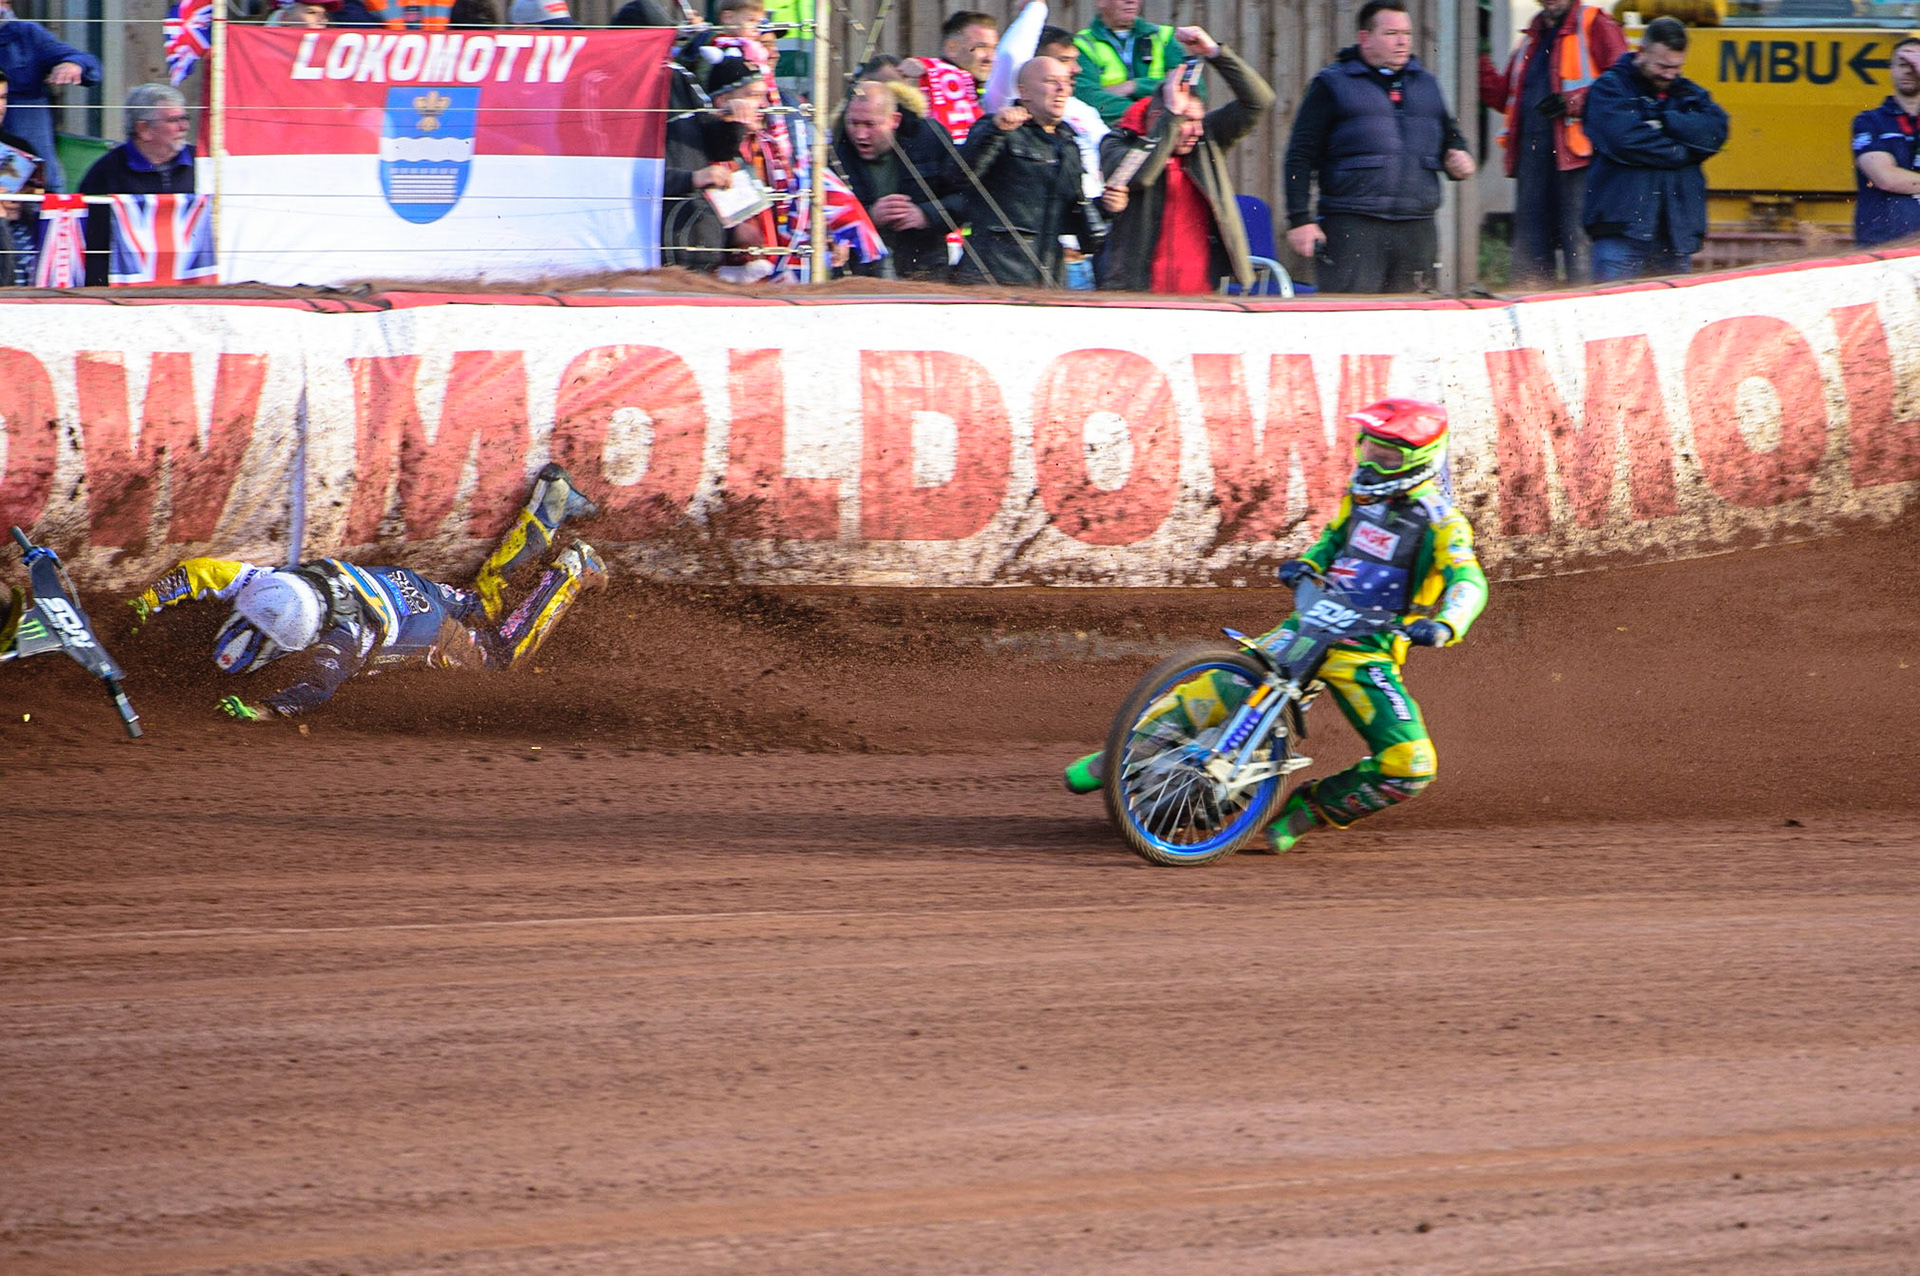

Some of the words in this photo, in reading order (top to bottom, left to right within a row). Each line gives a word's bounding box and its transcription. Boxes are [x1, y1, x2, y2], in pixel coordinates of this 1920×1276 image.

[290, 32, 588, 83] LOKOMOTIV
[1718, 39, 1843, 85] MBU
[343, 344, 1398, 548] MOLDOW
